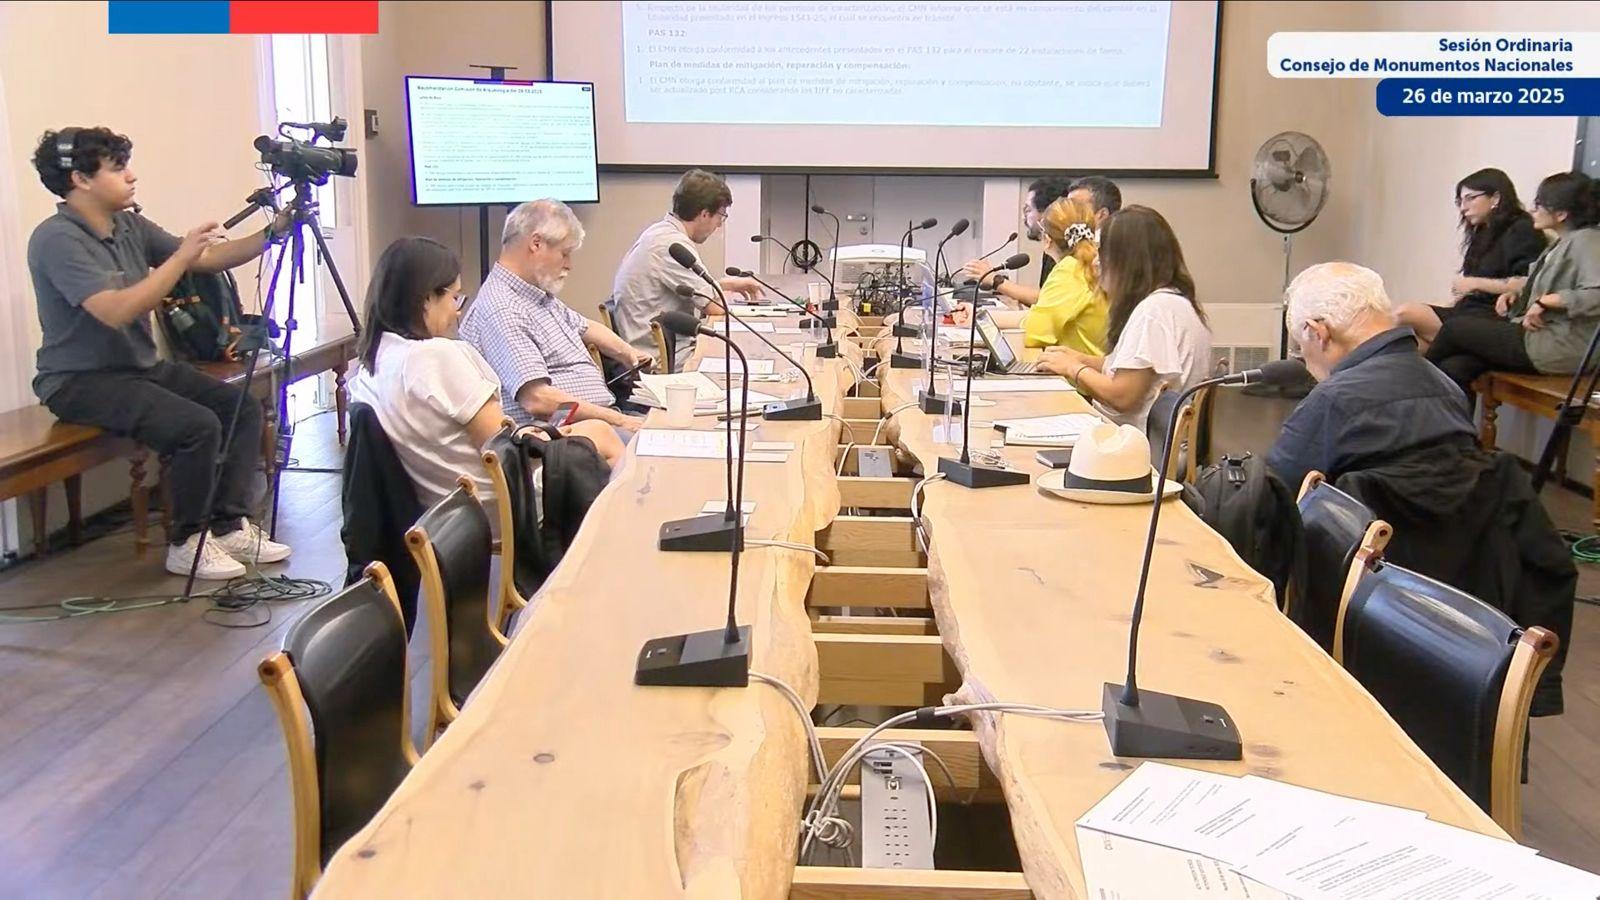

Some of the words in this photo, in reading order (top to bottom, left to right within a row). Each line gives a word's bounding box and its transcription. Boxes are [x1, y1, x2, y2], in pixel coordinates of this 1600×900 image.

[648, 29, 666, 37] PAS
[649, 60, 668, 68] Plan
[684, 61, 721, 69] medidas
[786, 61, 834, 71] reparación
